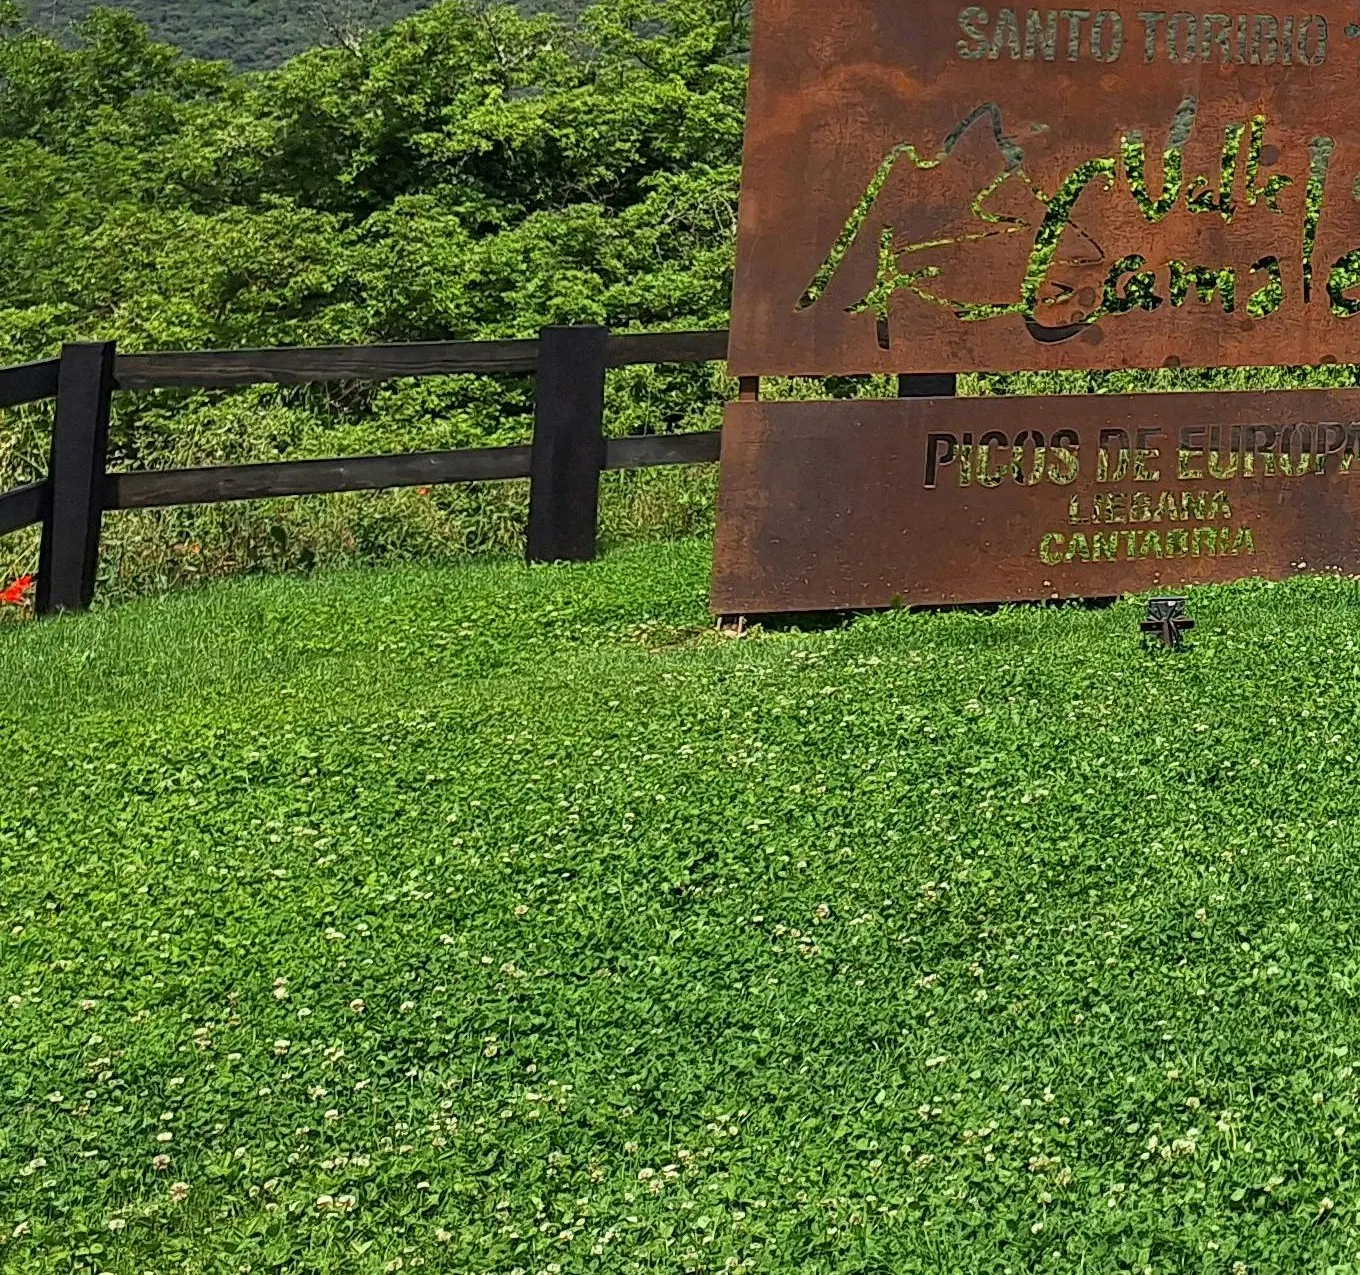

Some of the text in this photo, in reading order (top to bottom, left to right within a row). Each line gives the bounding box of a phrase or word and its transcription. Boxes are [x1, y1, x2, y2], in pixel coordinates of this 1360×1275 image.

[957, 6, 1329, 67] SANTO TORIBIO
[1121, 94, 1294, 225] Valle
[923, 429, 1082, 489] PICOS
[1097, 426, 1163, 483] DE
[1039, 526, 1258, 567] CANTABRIA
